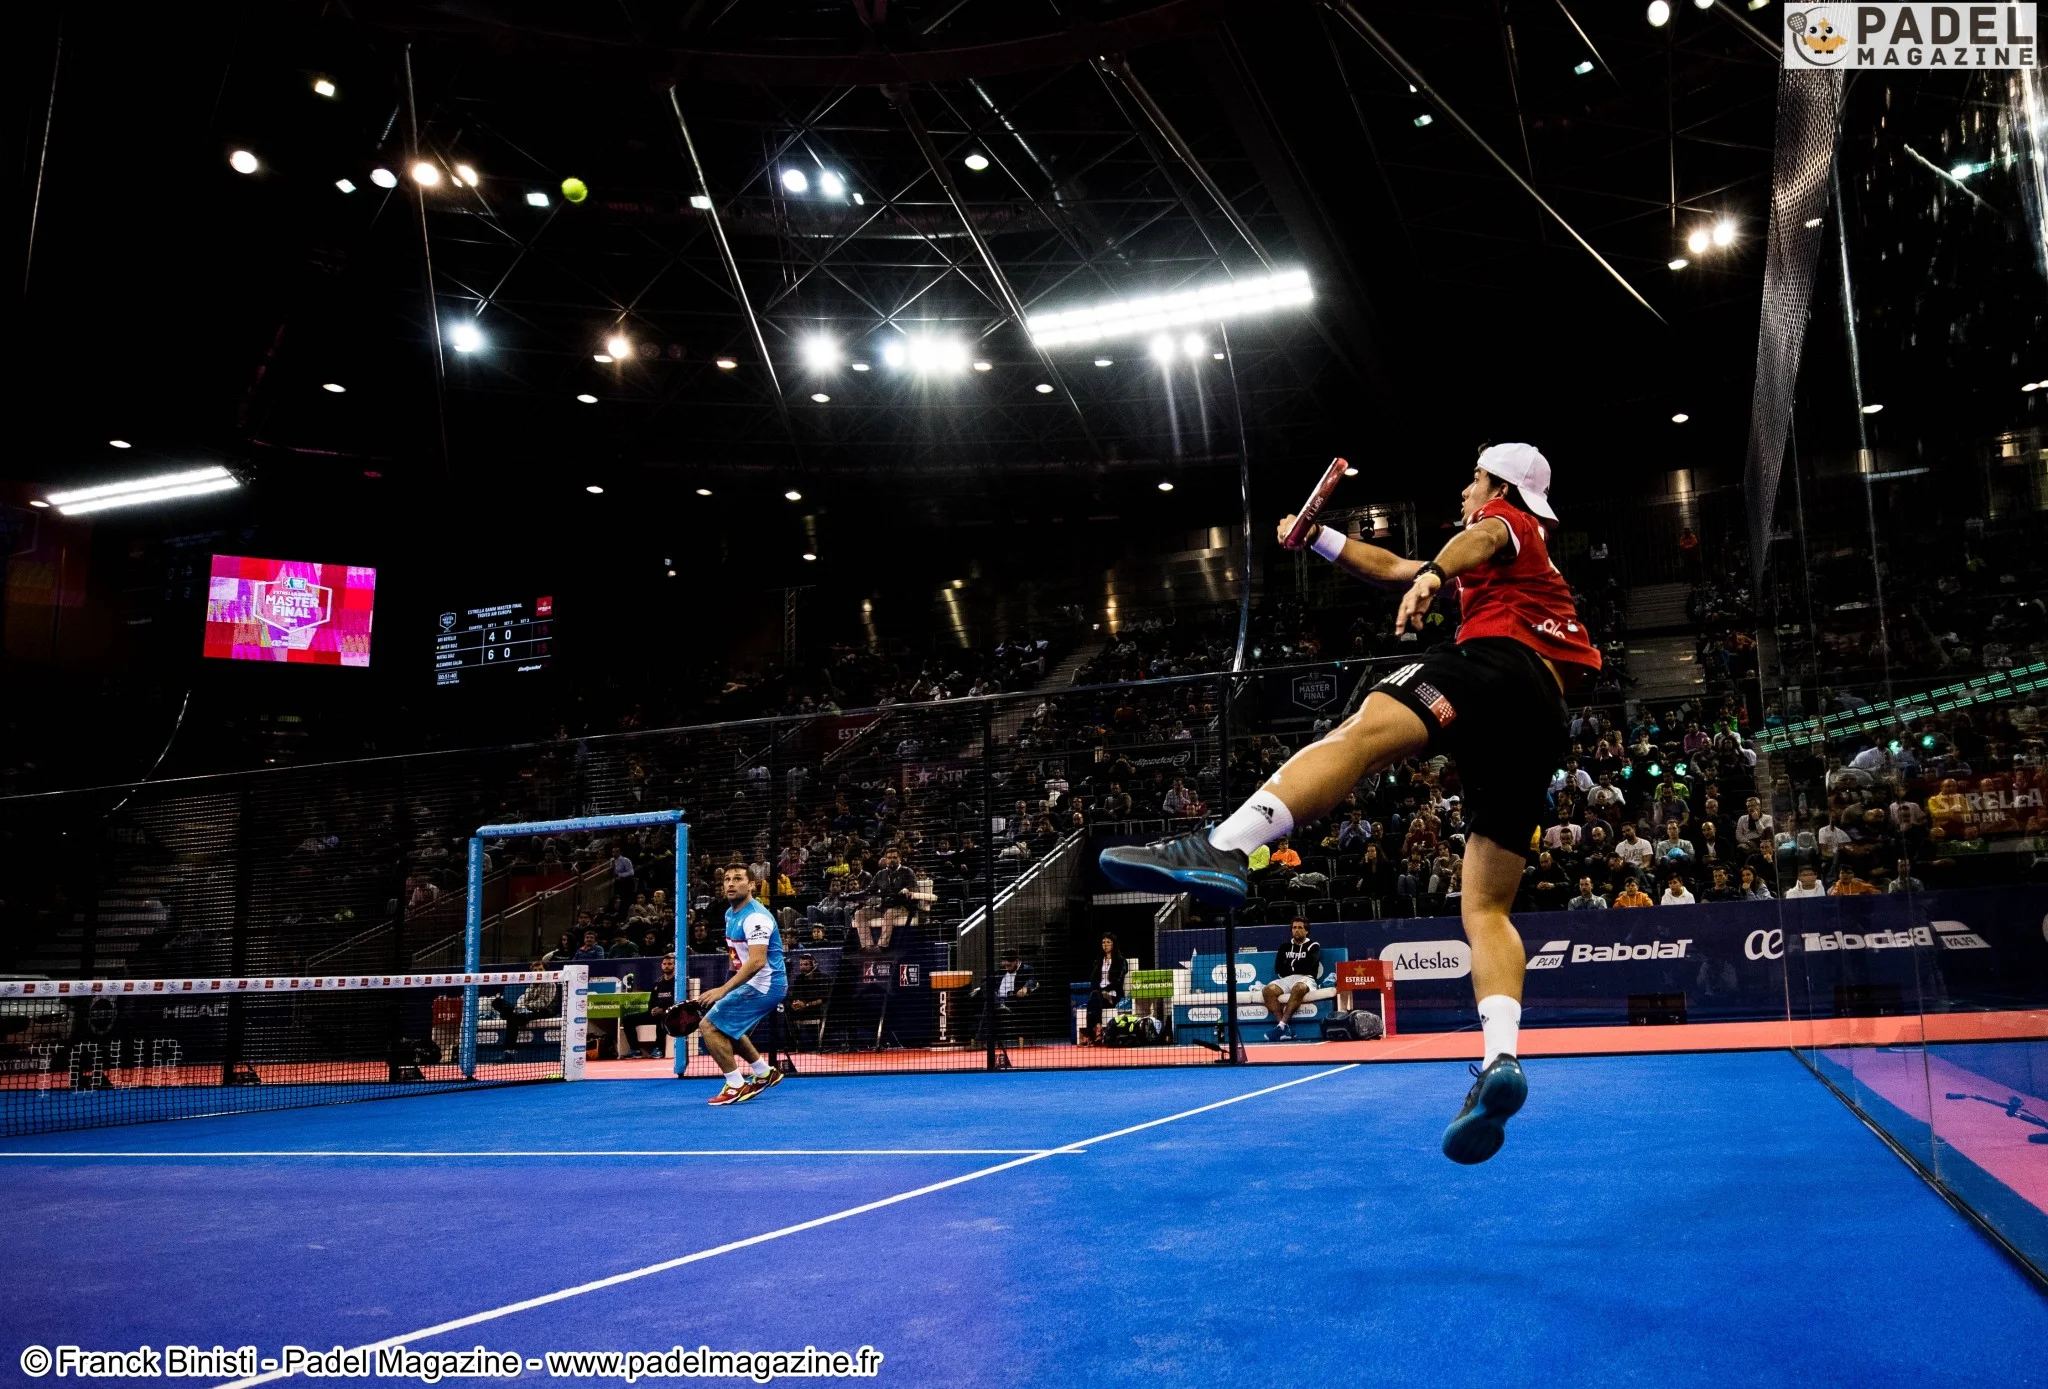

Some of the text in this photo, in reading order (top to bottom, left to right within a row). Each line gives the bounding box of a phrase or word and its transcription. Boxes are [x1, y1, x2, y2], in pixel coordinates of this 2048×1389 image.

[266, 594, 320, 608] MASTER
[272, 605, 312, 618] FINAL
[488, 632, 495, 642] 4
[505, 630, 512, 640] 0
[488, 650, 494, 660] 6
[504, 648, 510, 658] 0
[1299, 683, 1330, 693] MASTER
[1304, 692, 1326, 700] FINAL
[1394, 952, 1459, 971] Adeslas
[1536, 957, 1560, 967] PLAY
[1239, 1007, 1266, 1018] Adeslas
[1294, 1006, 1314, 1016] deslas
